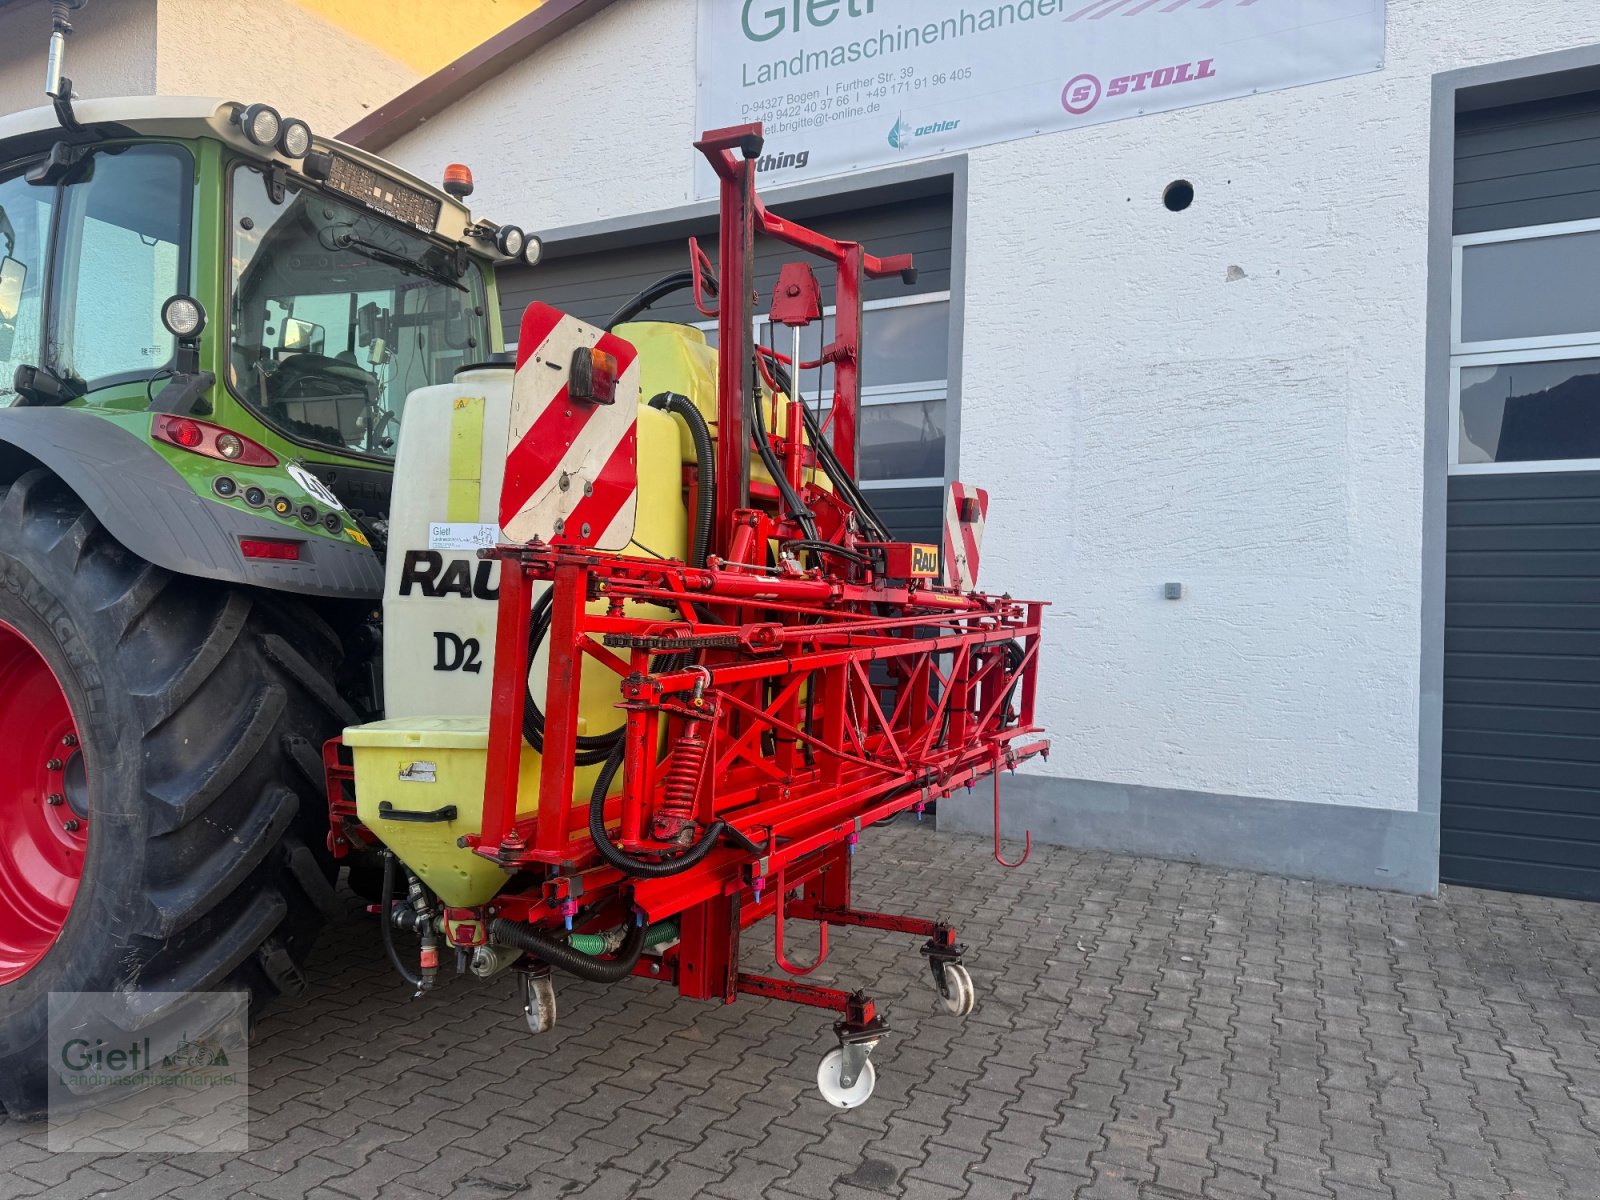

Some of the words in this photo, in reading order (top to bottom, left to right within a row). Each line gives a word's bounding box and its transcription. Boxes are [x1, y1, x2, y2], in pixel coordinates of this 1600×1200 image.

[741, 96, 784, 115] D-94327
[786, 90, 820, 104] Bogen
[836, 77, 874, 94] Further
[877, 72, 896, 84] Str.
[900, 66, 914, 79] 39
[776, 105, 801, 120] 9422
[804, 101, 817, 113] 40
[820, 98, 833, 110] 37
[836, 94, 850, 107] 66
[866, 86, 887, 98] +49
[891, 81, 909, 94] 171
[914, 77, 927, 89] 91
[932, 73, 946, 86] 96
[949, 66, 972, 81] 405
[1106, 58, 1216, 97] STOLL
[764, 102, 880, 135] etl.brigitte@t-online.de
[914, 119, 961, 137] oehler
[755, 150, 810, 173] thing
[432, 526, 451, 536] Gietl
[398, 550, 500, 600] RAU
[912, 547, 937, 572] RAU
[433, 631, 482, 675] D2
